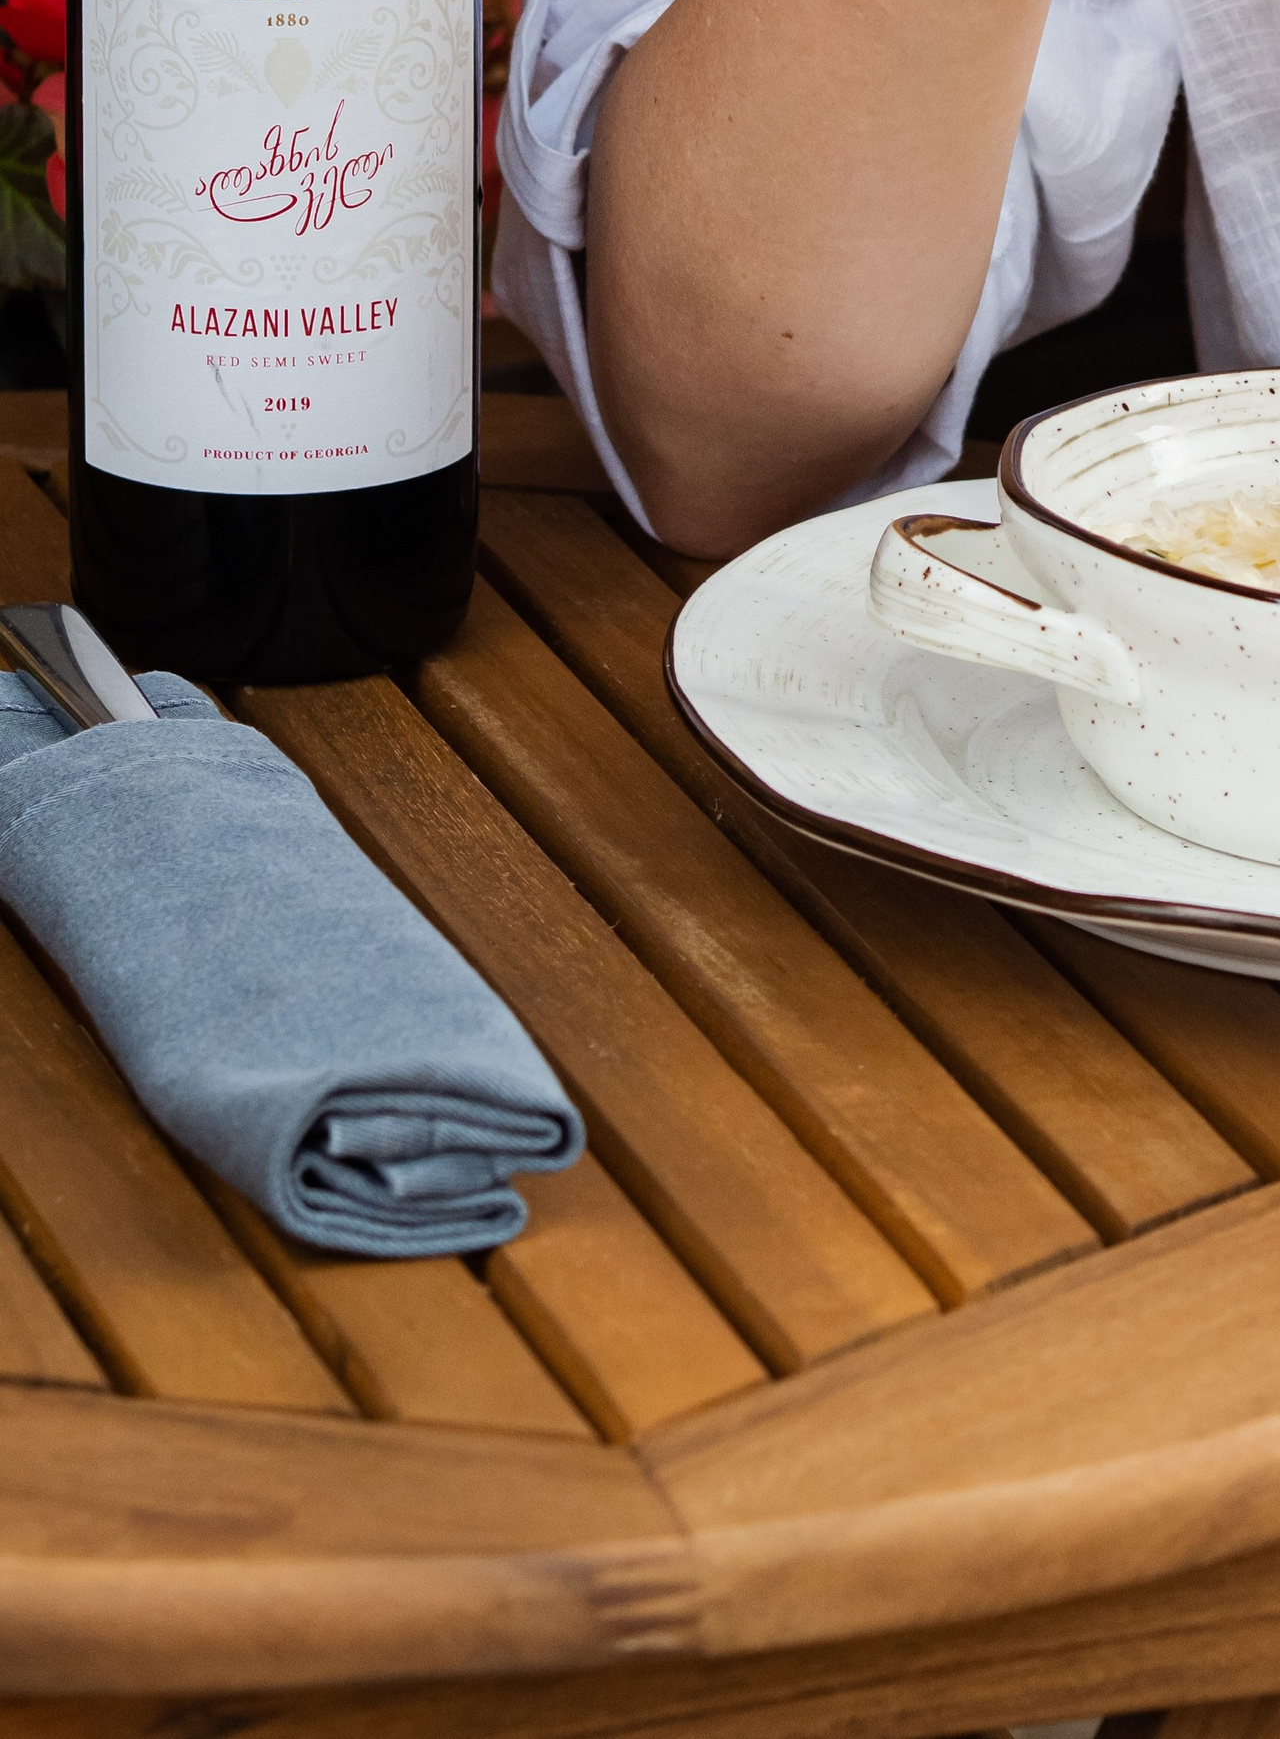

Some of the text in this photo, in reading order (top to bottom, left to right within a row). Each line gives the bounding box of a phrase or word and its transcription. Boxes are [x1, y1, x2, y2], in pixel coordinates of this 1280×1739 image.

[266, 13, 309, 27] 1880
[170, 297, 398, 338] ALAZANI VALLEY
[206, 350, 367, 368] RED SEMI SWEET
[264, 397, 311, 412] 2019
[203, 445, 369, 460] PRODUCT OF GEORGIA
